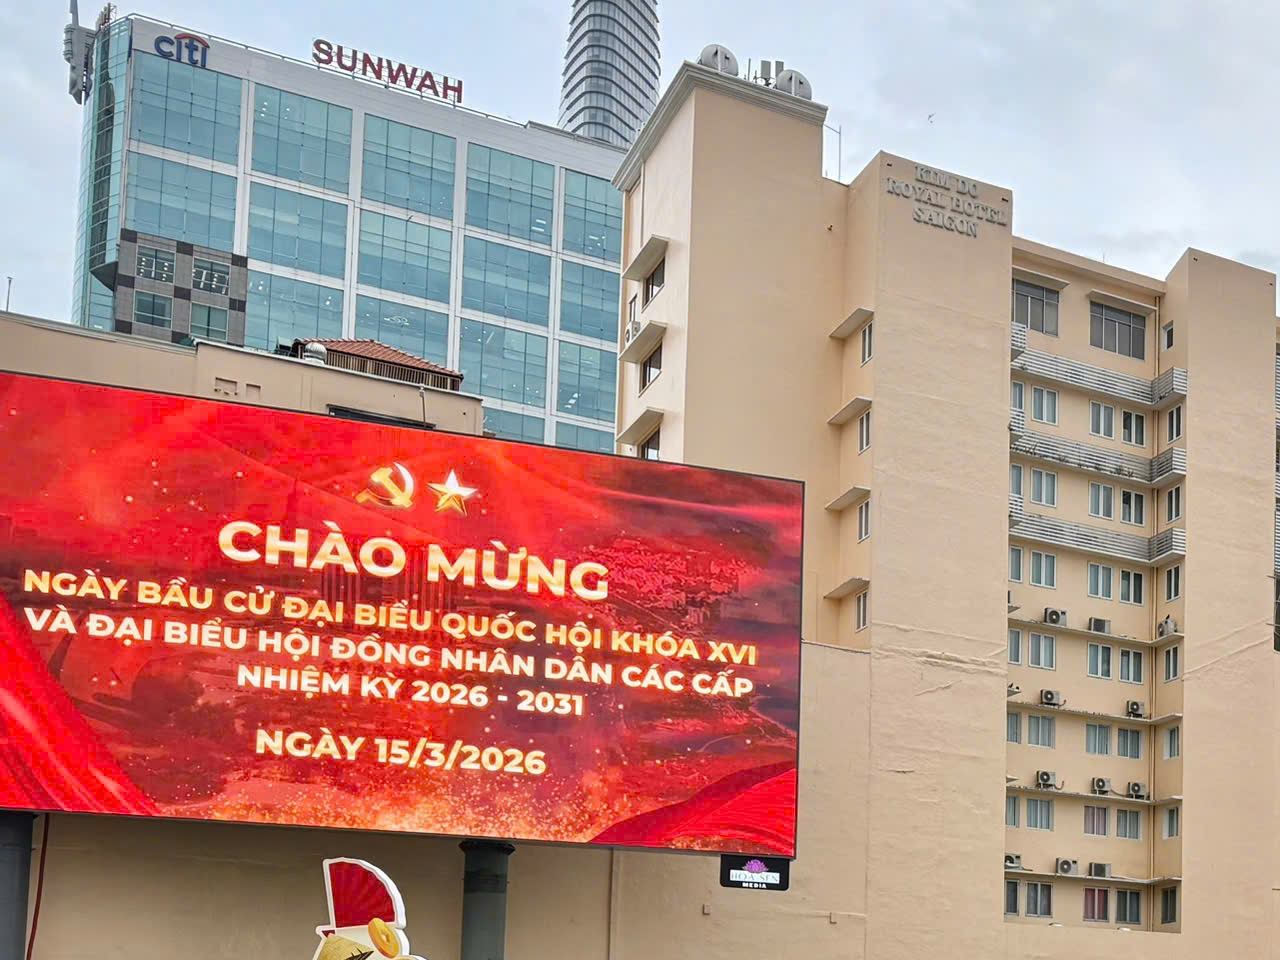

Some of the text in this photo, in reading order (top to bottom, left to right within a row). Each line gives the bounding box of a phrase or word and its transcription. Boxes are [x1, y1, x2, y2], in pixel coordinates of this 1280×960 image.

[154, 32, 210, 67] citi
[312, 38, 463, 103] SUNWAH
[887, 177, 1008, 227] ROYAL HOTEL
[915, 165, 951, 190] KIM
[913, 206, 978, 238] SAIGON
[218, 520, 609, 601] CHÀO MỪNG
[24, 569, 757, 666] NGÀY BẦU CỬ ĐẠI BIỂU QUỐC HỘI KHÓA XVI
[24, 604, 754, 698] VÀ ĐẠI BIỂU HỘI ĐỒNG NHÂN DÂN CÁC CẤP
[237, 664, 350, 698] NHIỆM
[361, 668, 406, 700] KỲ
[411, 680, 489, 708] 2026
[516, 689, 584, 716] 2031
[256, 727, 547, 775] NGÀY 15/3/2026
